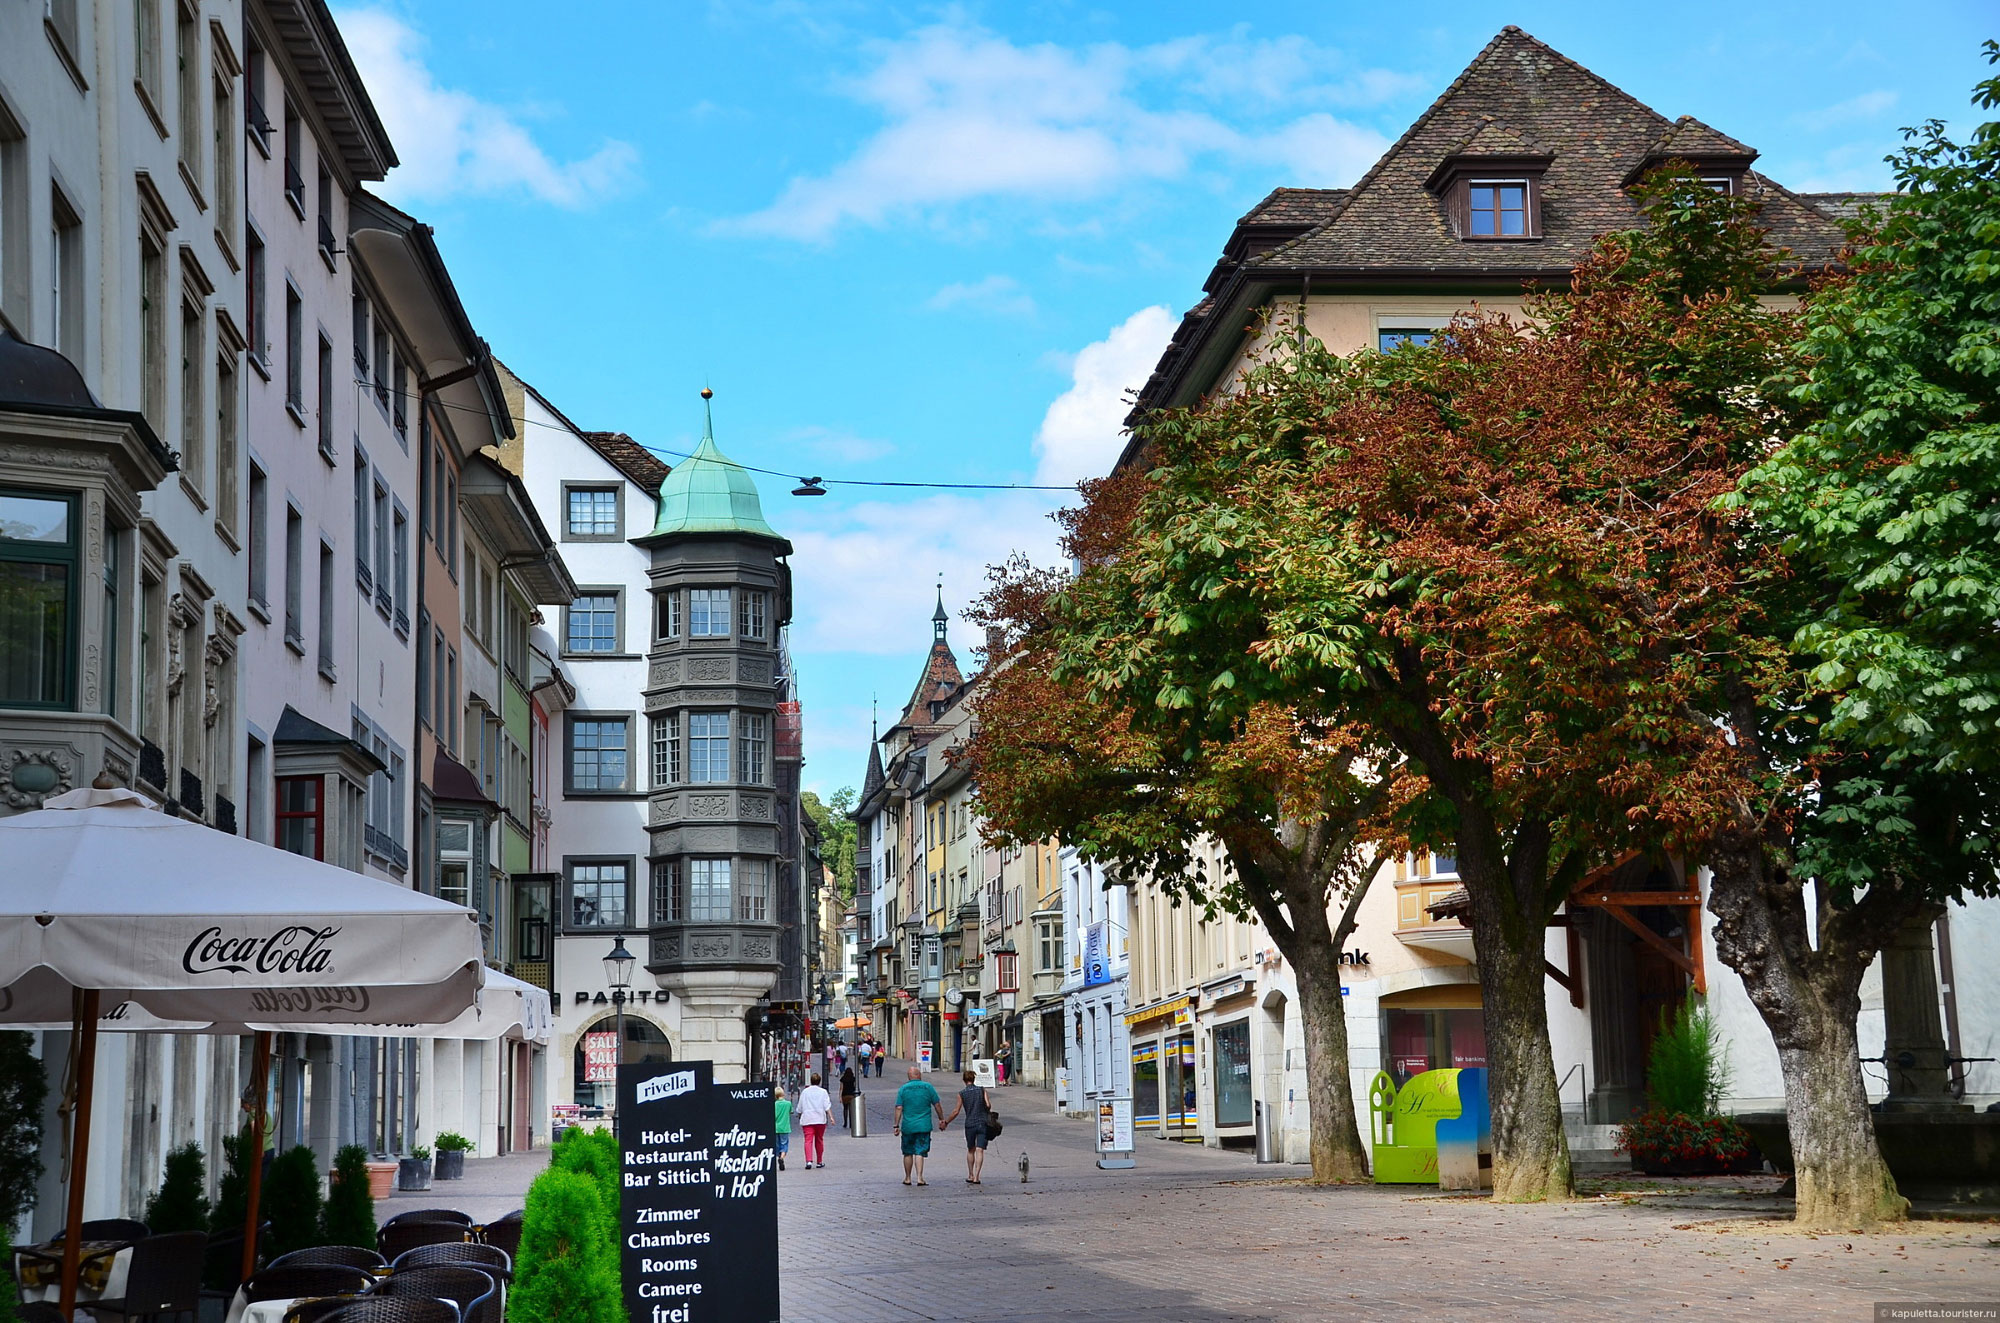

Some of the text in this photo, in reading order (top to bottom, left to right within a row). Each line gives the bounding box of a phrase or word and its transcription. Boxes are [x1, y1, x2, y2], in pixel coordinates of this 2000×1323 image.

[183, 926, 342, 974] Coca-Cola
[644, 1075, 688, 1098] rivella
[730, 1089, 767, 1099] VALSER
[641, 1128, 692, 1145] Hotel-
[625, 1148, 709, 1165] Restaurant
[624, 1168, 711, 1187] Bar Sittich
[731, 1175, 765, 1198] Hof
[636, 1207, 701, 1224] Zimmer
[627, 1230, 711, 1249] Chambres
[641, 1258, 698, 1273] Rooms
[638, 1282, 703, 1298] Camere
[652, 1302, 690, 1323] frei
